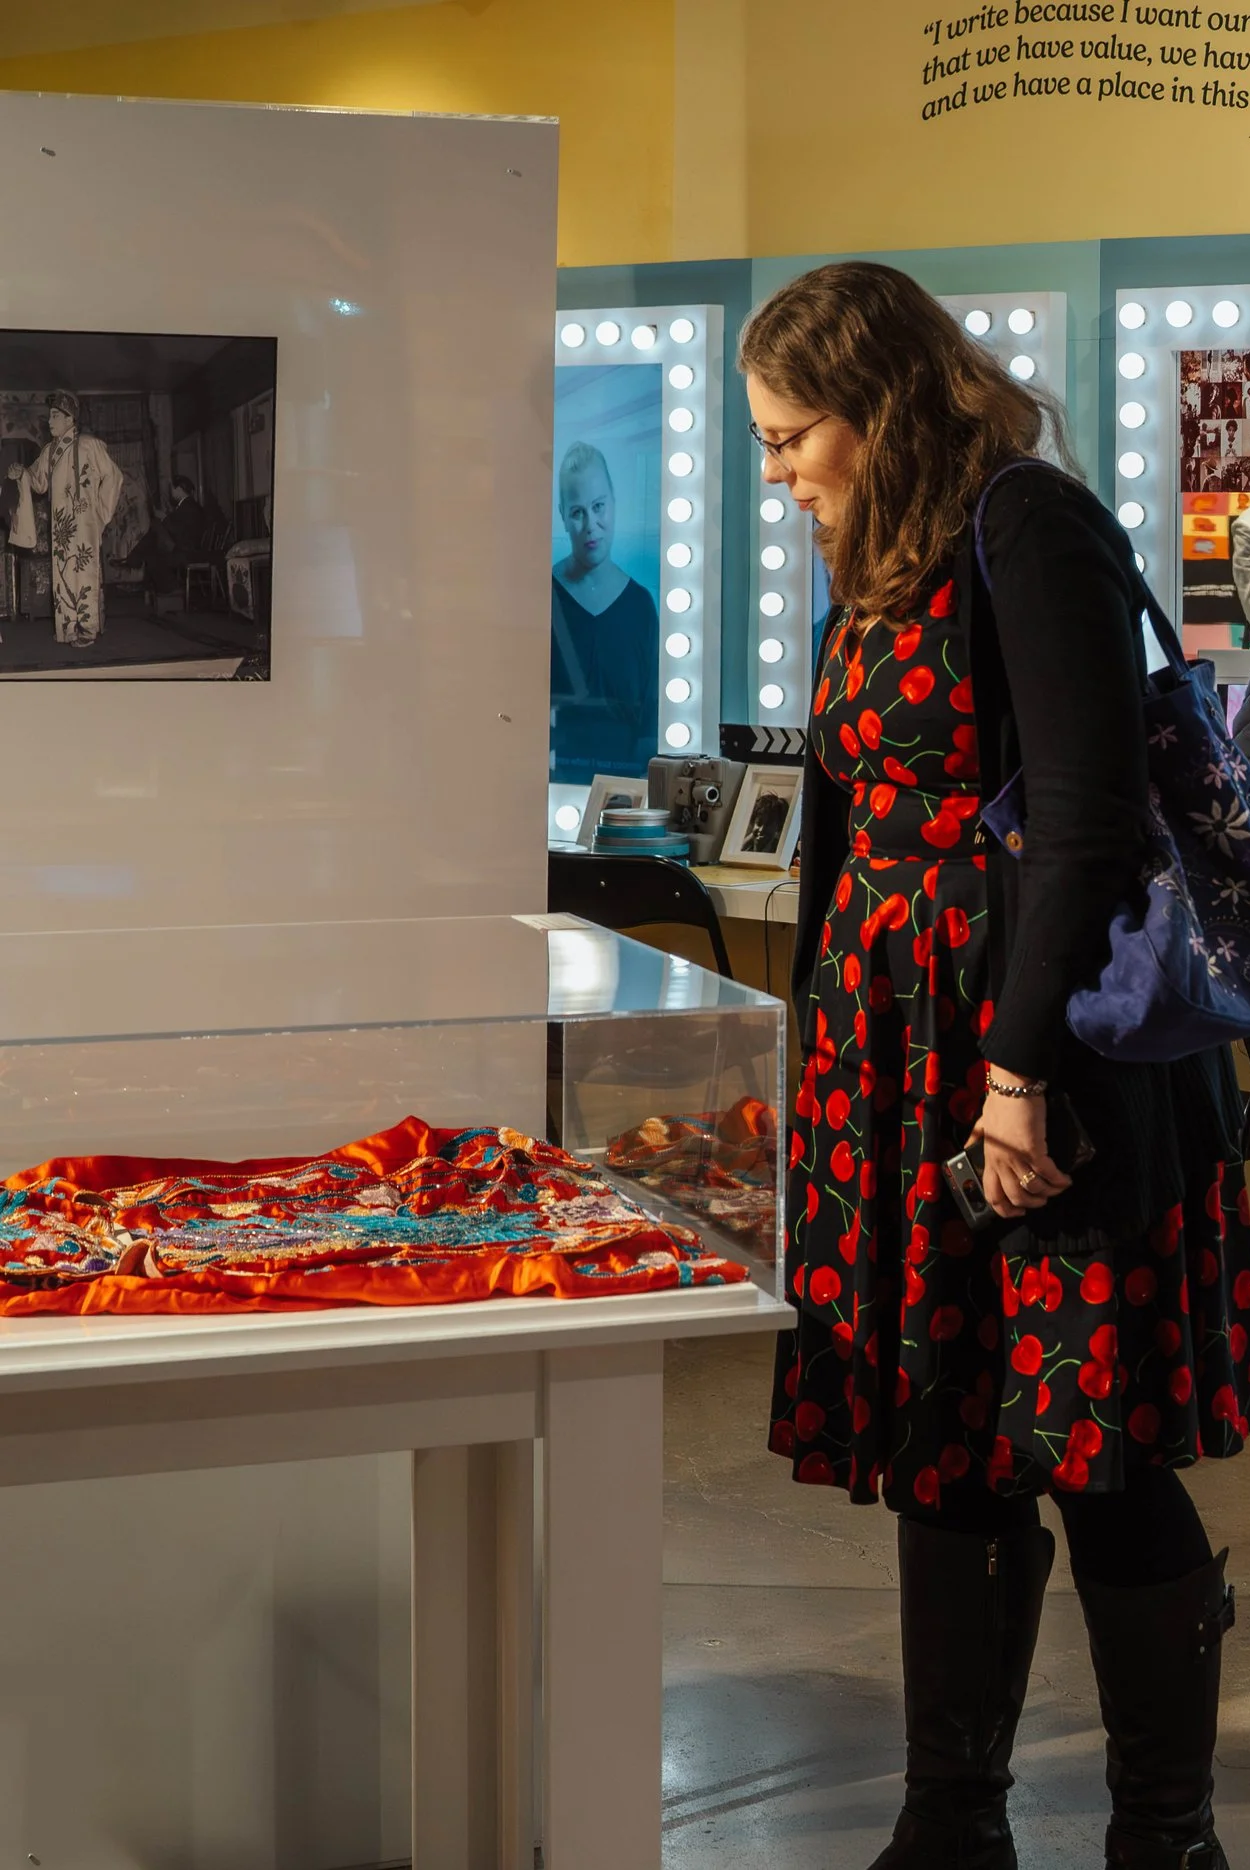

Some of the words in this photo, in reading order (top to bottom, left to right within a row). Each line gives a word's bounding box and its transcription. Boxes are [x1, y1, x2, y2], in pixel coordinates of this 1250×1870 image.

[946, 4, 1009, 39] write
[1014, 0, 1115, 24] because
[1120, 0, 1130, 23] I
[1135, 5, 1202, 29] want
[922, 47, 971, 85] that
[976, 43, 1010, 67] we
[1016, 35, 1074, 60] have
[1080, 34, 1152, 67] value,
[1159, 45, 1197, 66] we
[921, 81, 967, 120] and
[972, 80, 1007, 104] we
[1013, 71, 1070, 97] have
[1076, 77, 1092, 96] a
[1097, 71, 1165, 101] place
[1171, 76, 1195, 104] in
[1201, 80, 1249, 109] this
